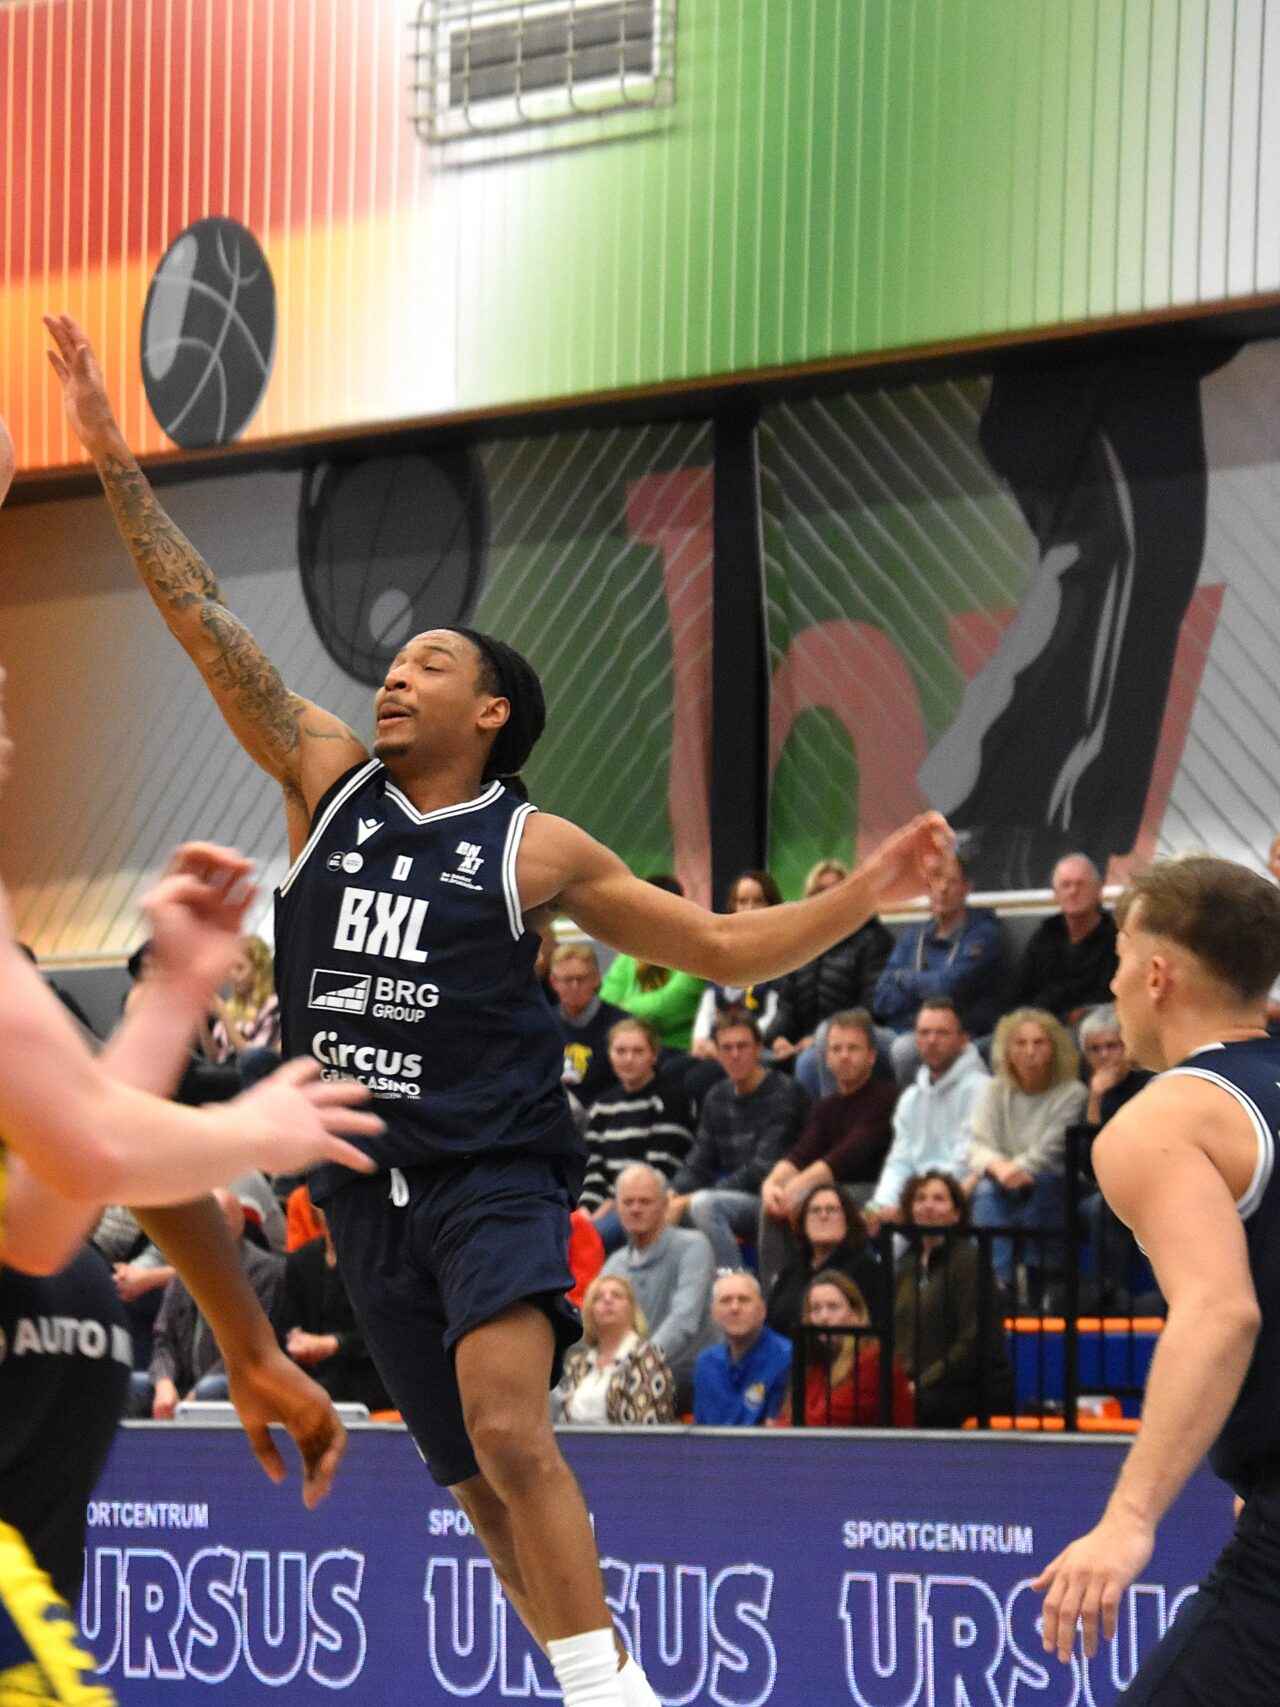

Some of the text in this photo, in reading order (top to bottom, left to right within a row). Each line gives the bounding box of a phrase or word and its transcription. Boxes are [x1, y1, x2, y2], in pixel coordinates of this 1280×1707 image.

[333, 887, 430, 963] BXL
[372, 1003, 426, 1023] GROUP
[374, 977, 440, 1008] BRG
[311, 1030, 424, 1078] Circus
[13, 1316, 107, 1358] AUTO
[86, 1501, 210, 1528] ORTCENTRUM
[843, 1520, 1035, 1554] SPORTCENTRUM
[80, 1545, 367, 1688] URSUS
[837, 1571, 1200, 1707] URSU
